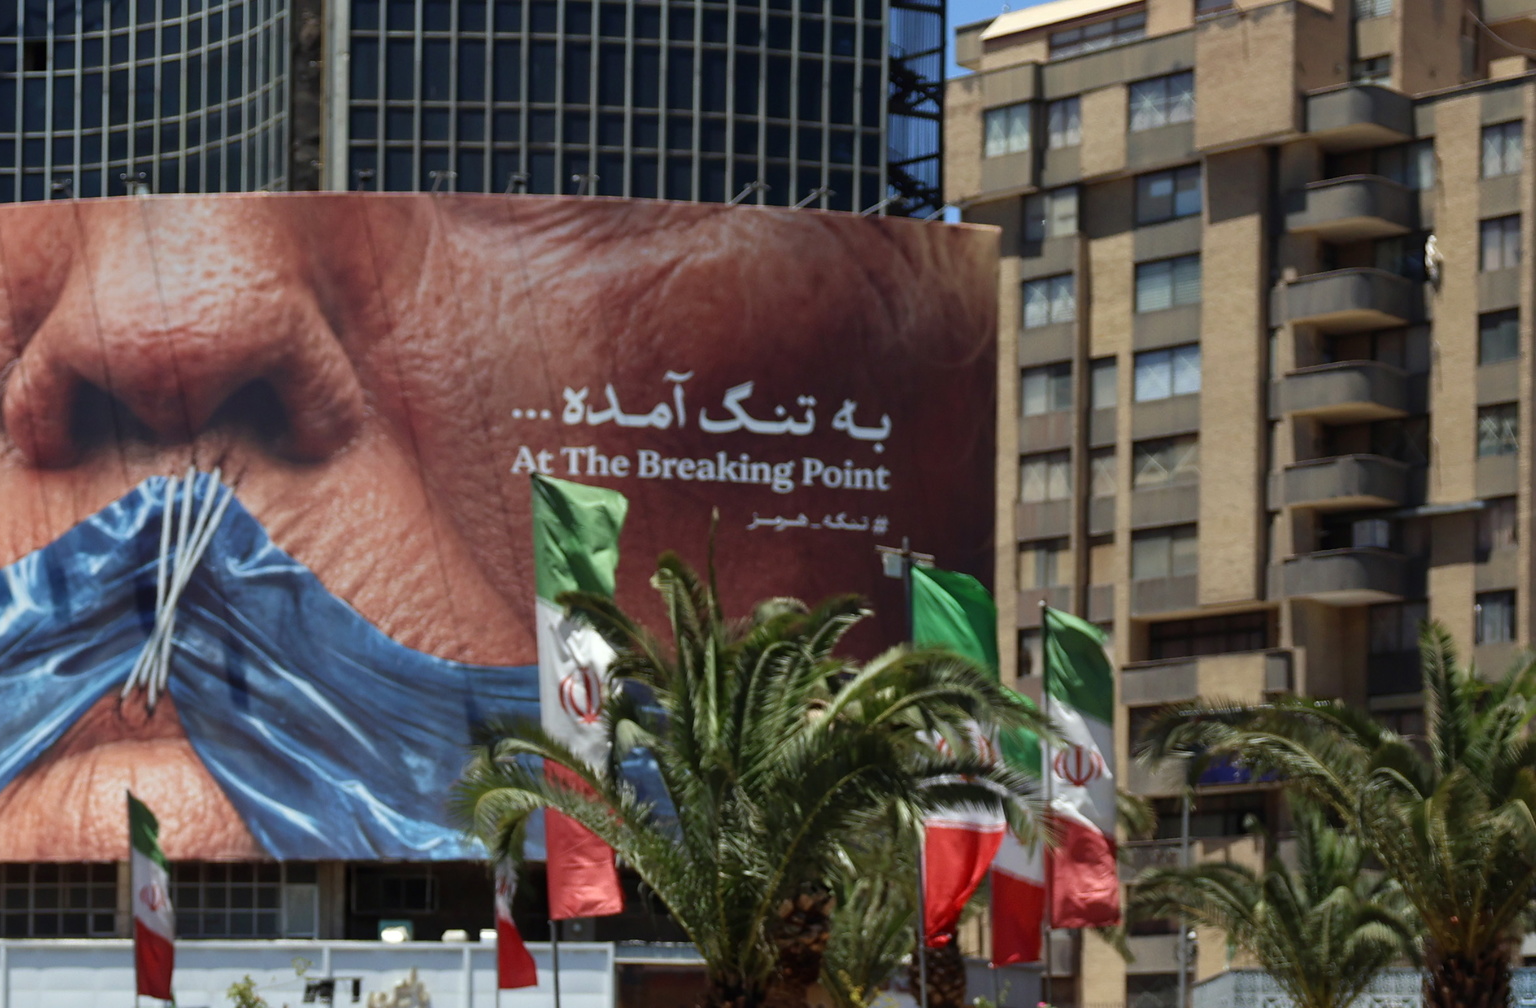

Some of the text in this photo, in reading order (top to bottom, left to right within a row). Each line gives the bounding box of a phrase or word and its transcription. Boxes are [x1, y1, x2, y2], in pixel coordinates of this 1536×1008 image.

[698, 380, 817, 436] تنگ
[832, 398, 892, 454] به
[510, 445, 891, 494] At The Breaking Point
